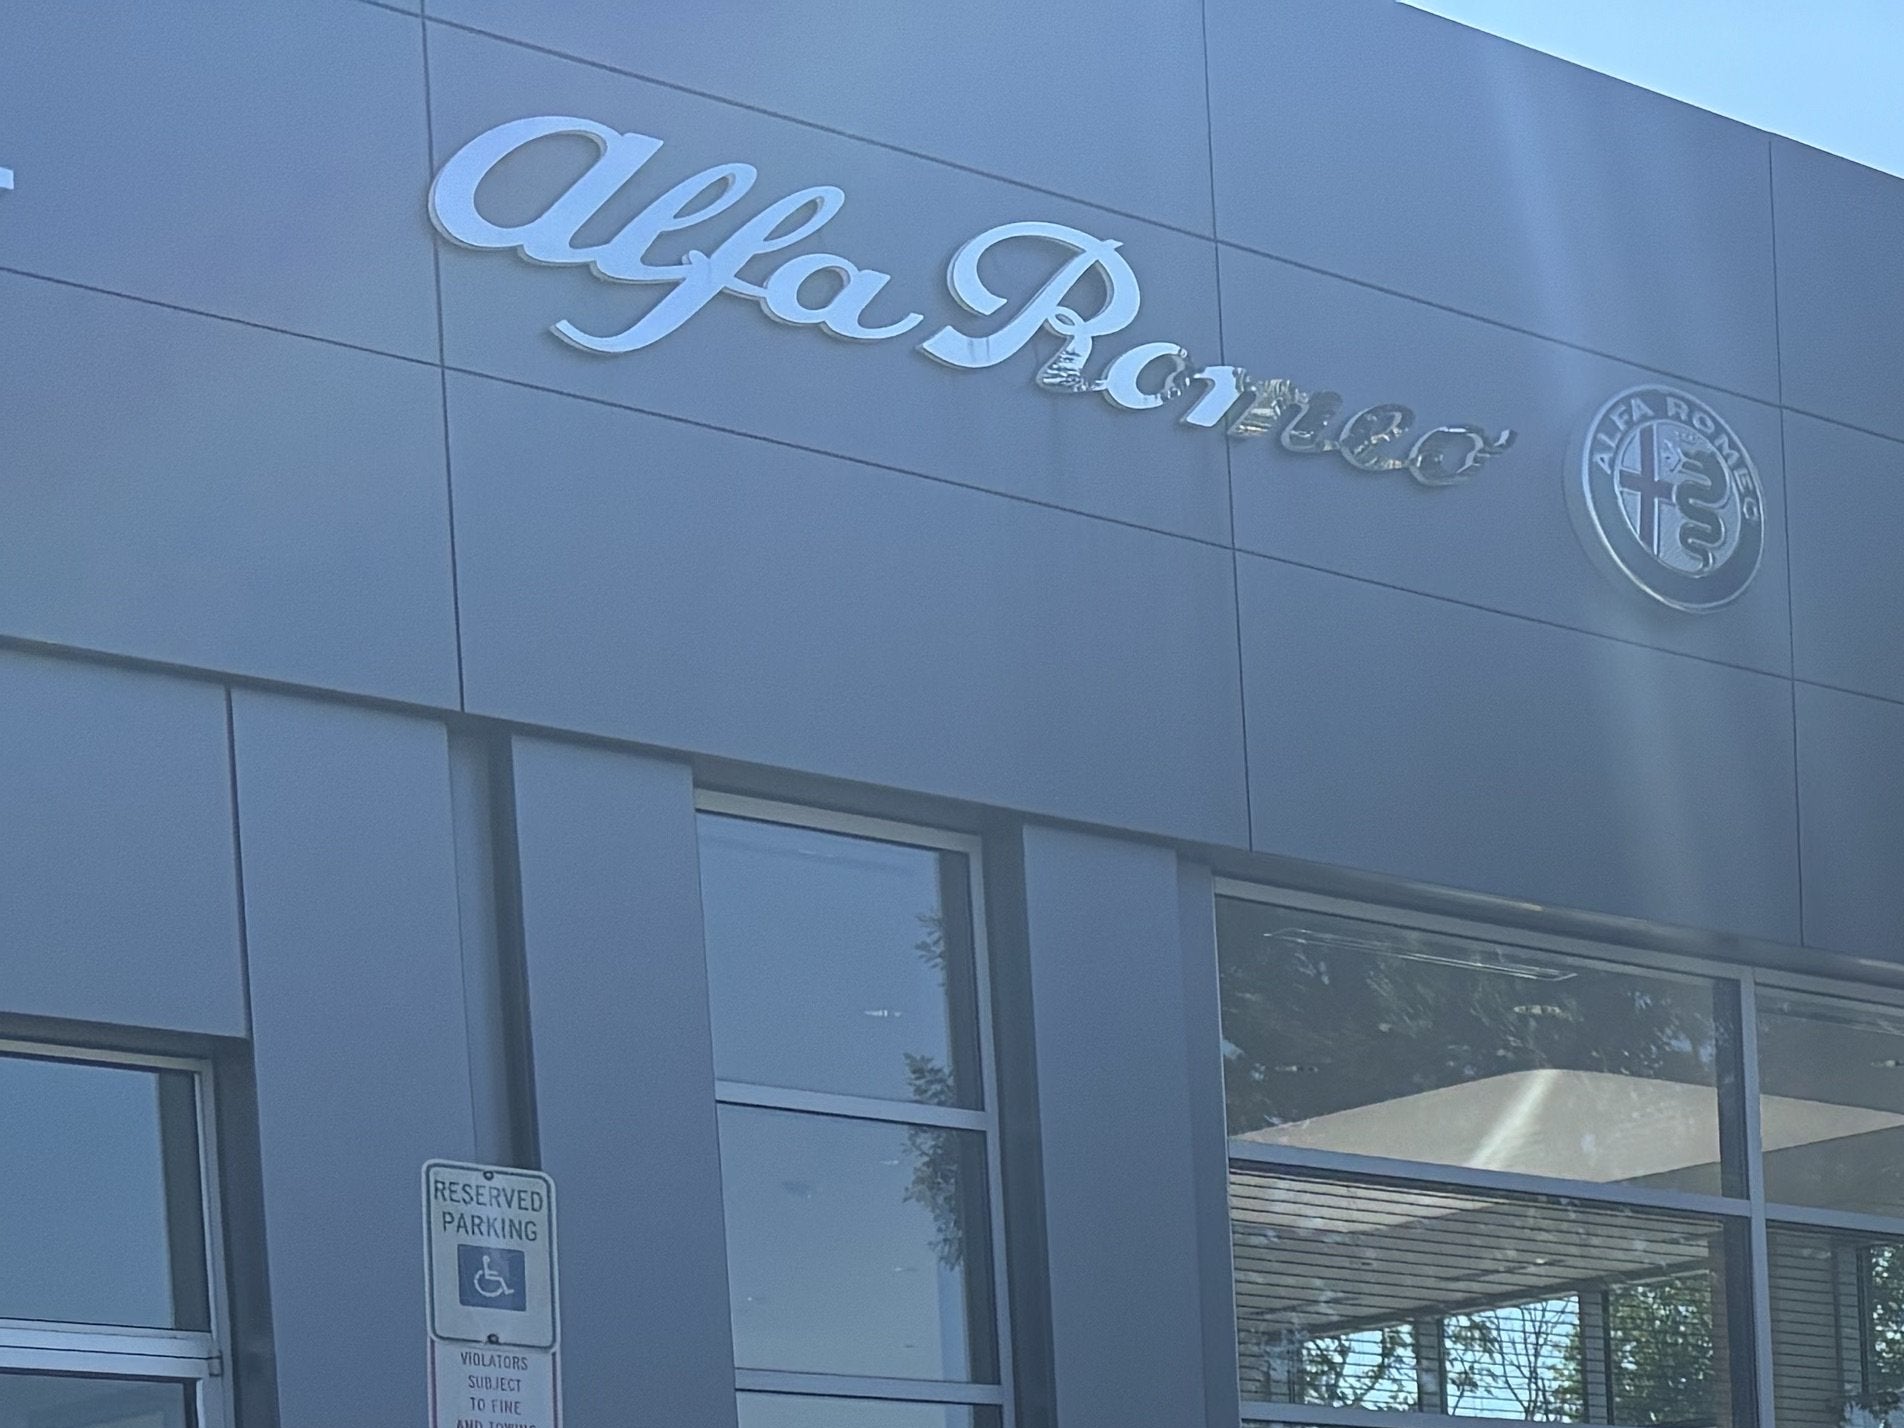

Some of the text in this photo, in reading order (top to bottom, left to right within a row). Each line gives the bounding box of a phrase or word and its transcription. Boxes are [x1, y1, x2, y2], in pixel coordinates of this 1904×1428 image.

[430, 116, 1517, 487] Alfa Romeo
[1592, 396, 1758, 521] ALFA ROMEO
[434, 1180, 543, 1212] RESERVED
[442, 1211, 538, 1241] PARKING
[460, 1352, 528, 1370] VIOLATORS
[468, 1375, 521, 1392] SUBJECT
[470, 1397, 522, 1416] TO FINE
